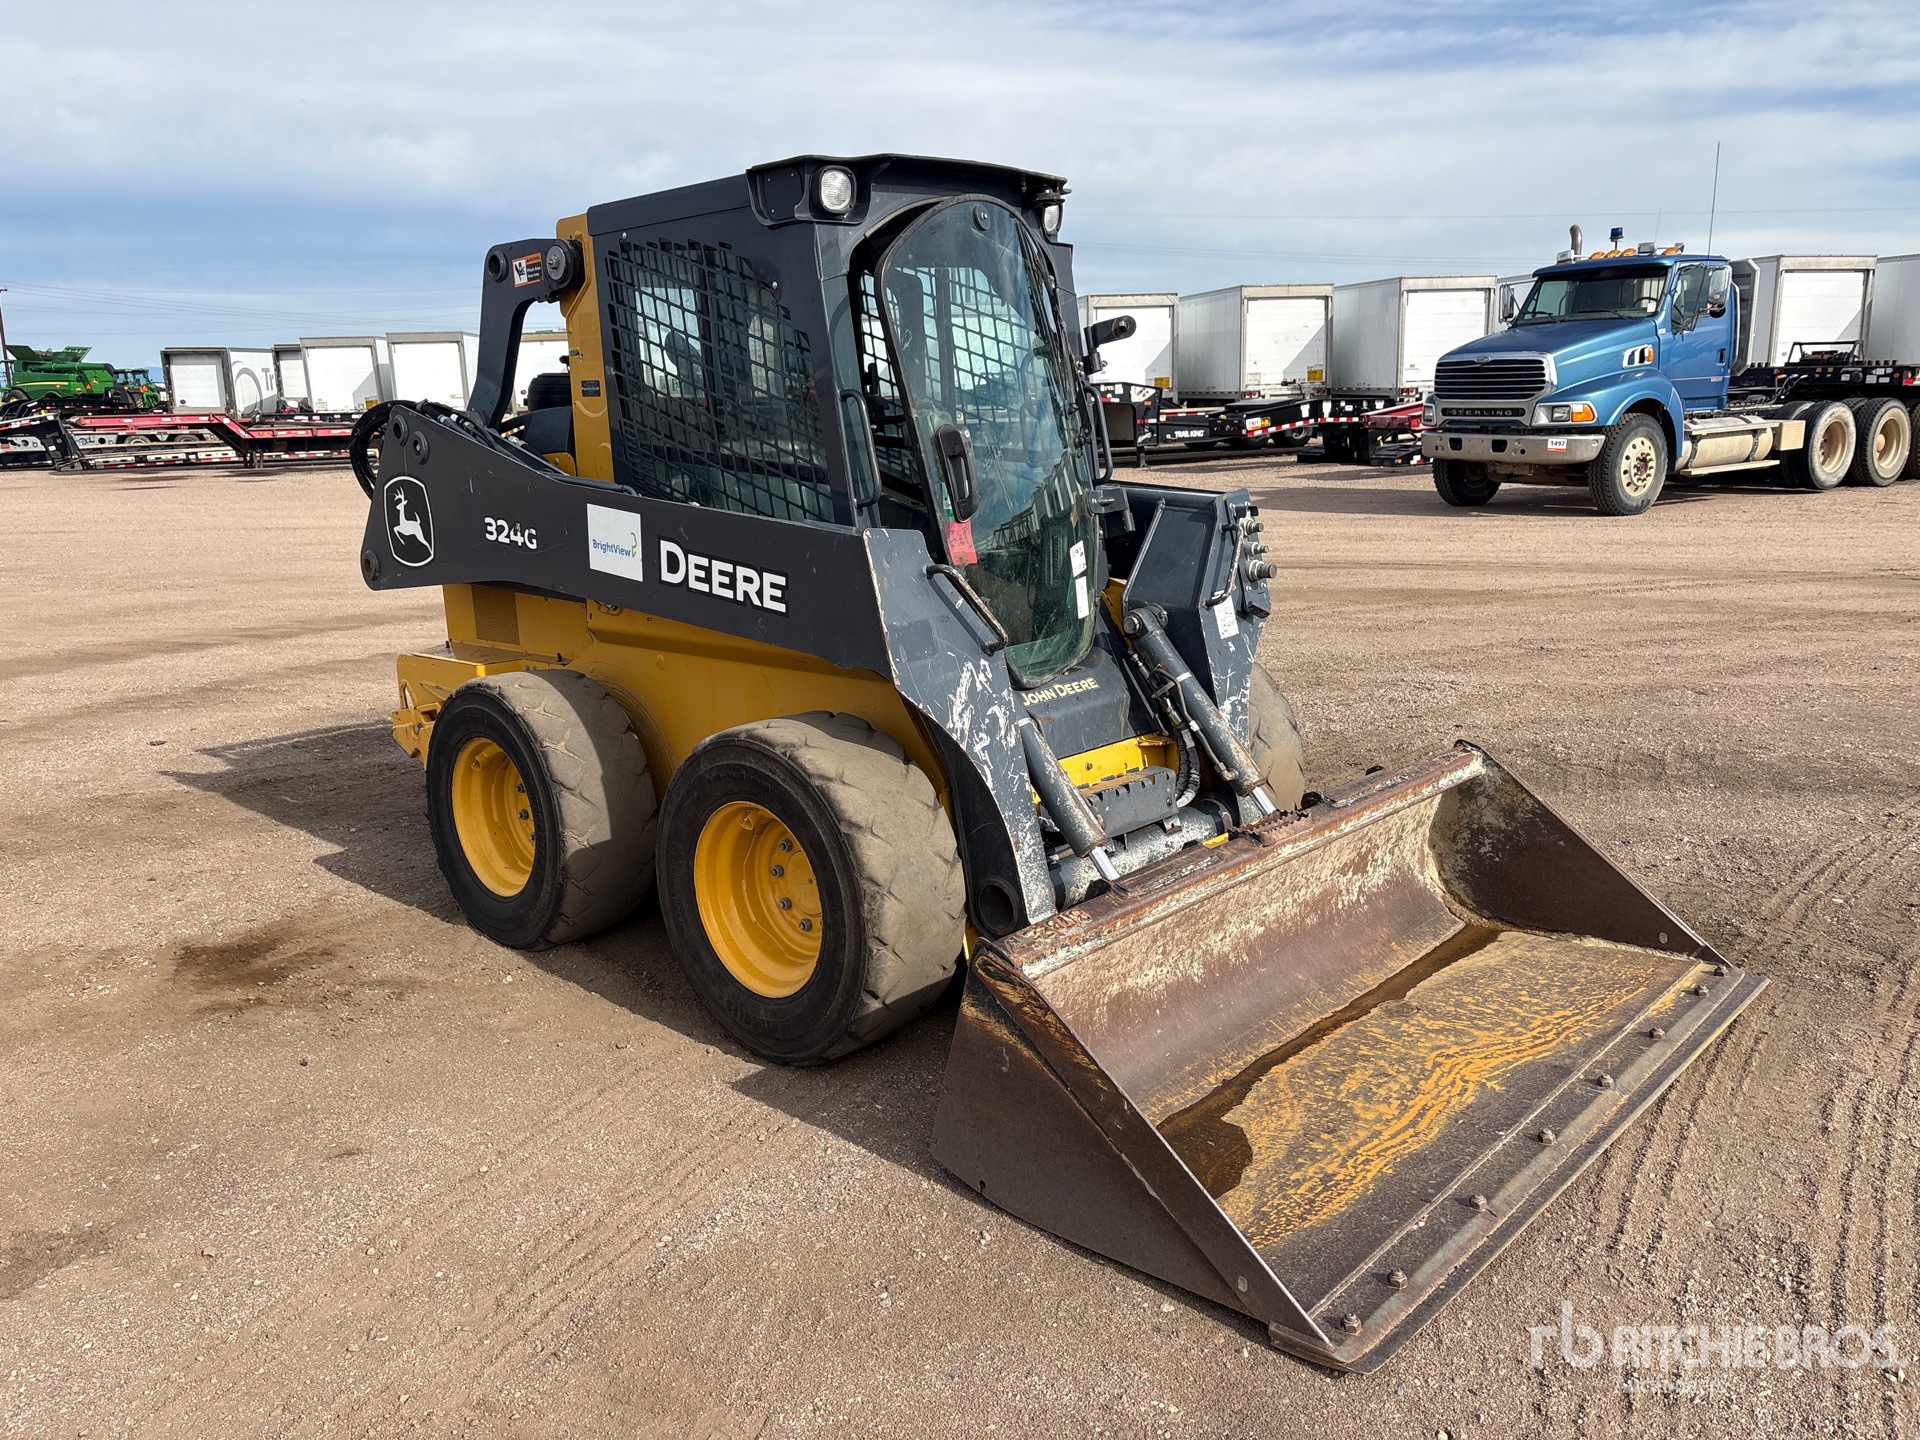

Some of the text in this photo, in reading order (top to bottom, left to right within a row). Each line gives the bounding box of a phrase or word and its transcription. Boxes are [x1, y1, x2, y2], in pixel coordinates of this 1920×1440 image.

[1174, 430, 1205, 438] TRAIL KING
[484, 516, 538, 550] 324G
[592, 539, 631, 557] BrightView
[660, 539, 787, 613] DEERE
[1021, 677, 1099, 707] JOHN DEERE
